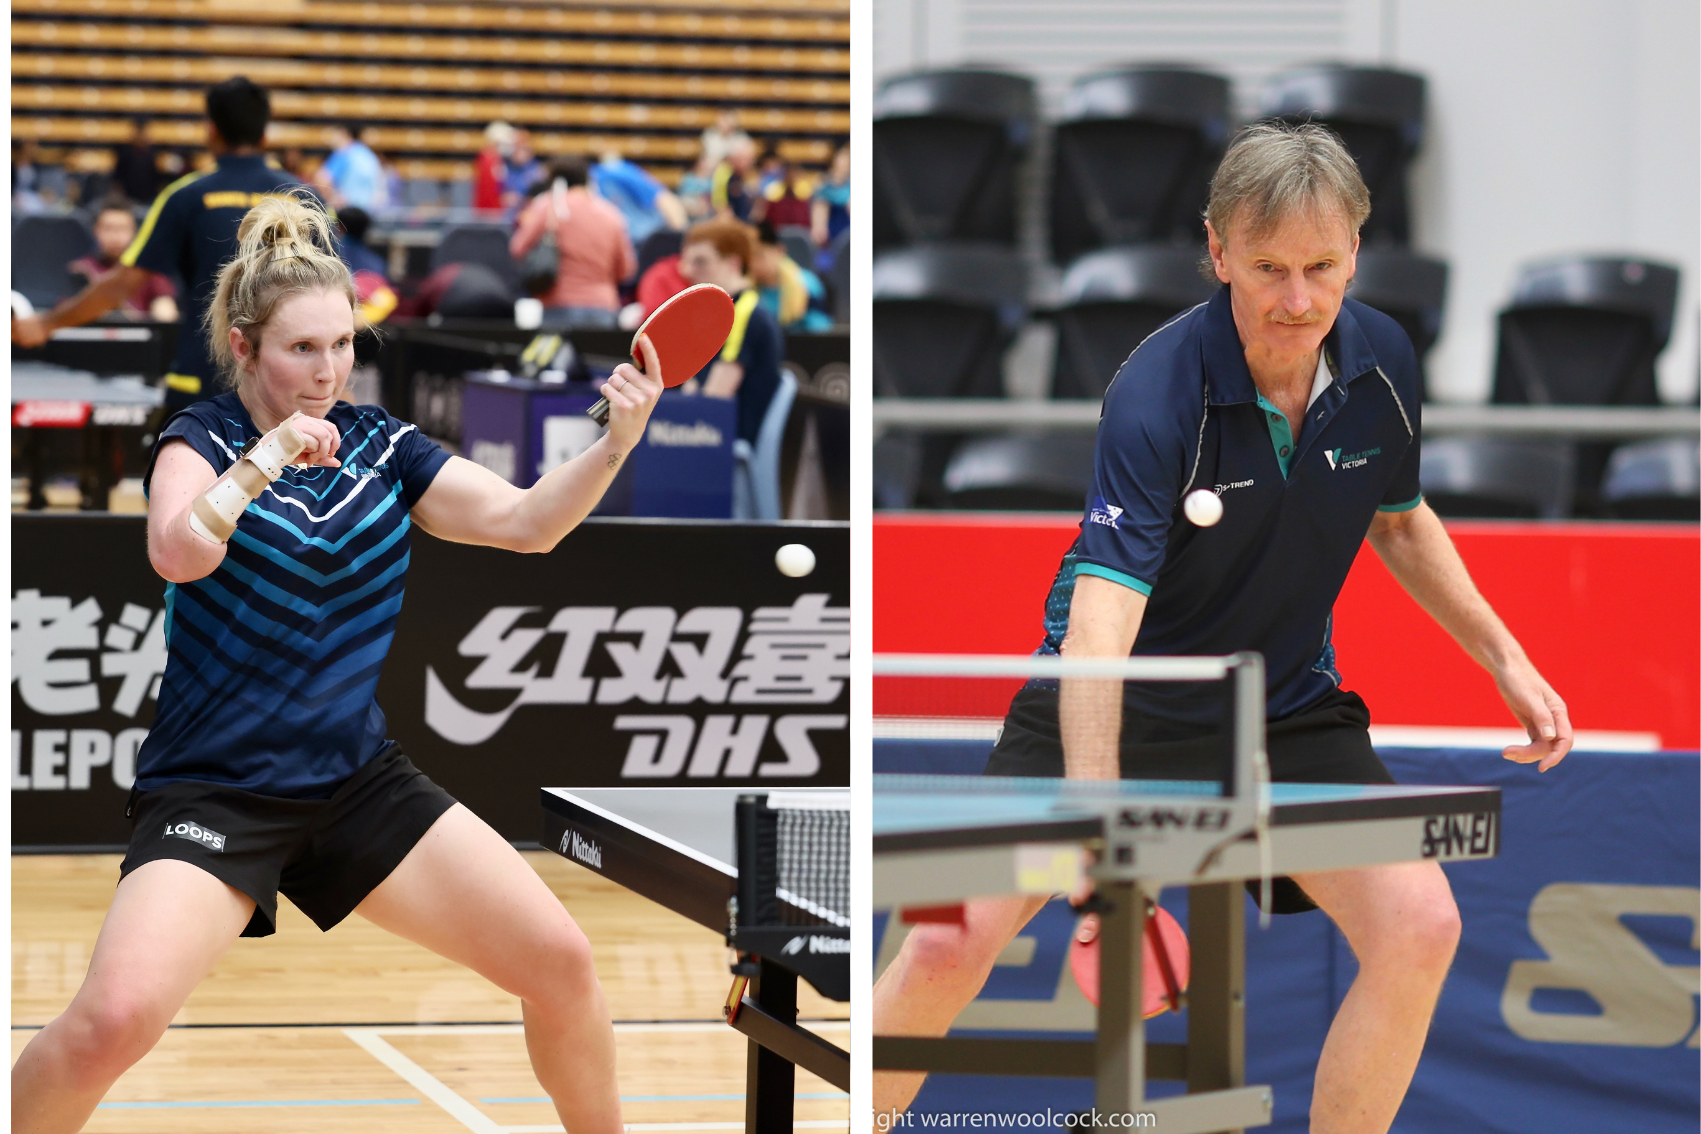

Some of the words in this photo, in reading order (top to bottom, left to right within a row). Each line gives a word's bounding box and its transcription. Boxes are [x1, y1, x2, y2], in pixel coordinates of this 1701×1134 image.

[1341, 457, 1368, 470] VICTORIA
[613, 714, 848, 778] DHS
[166, 823, 223, 849] LOOPS
